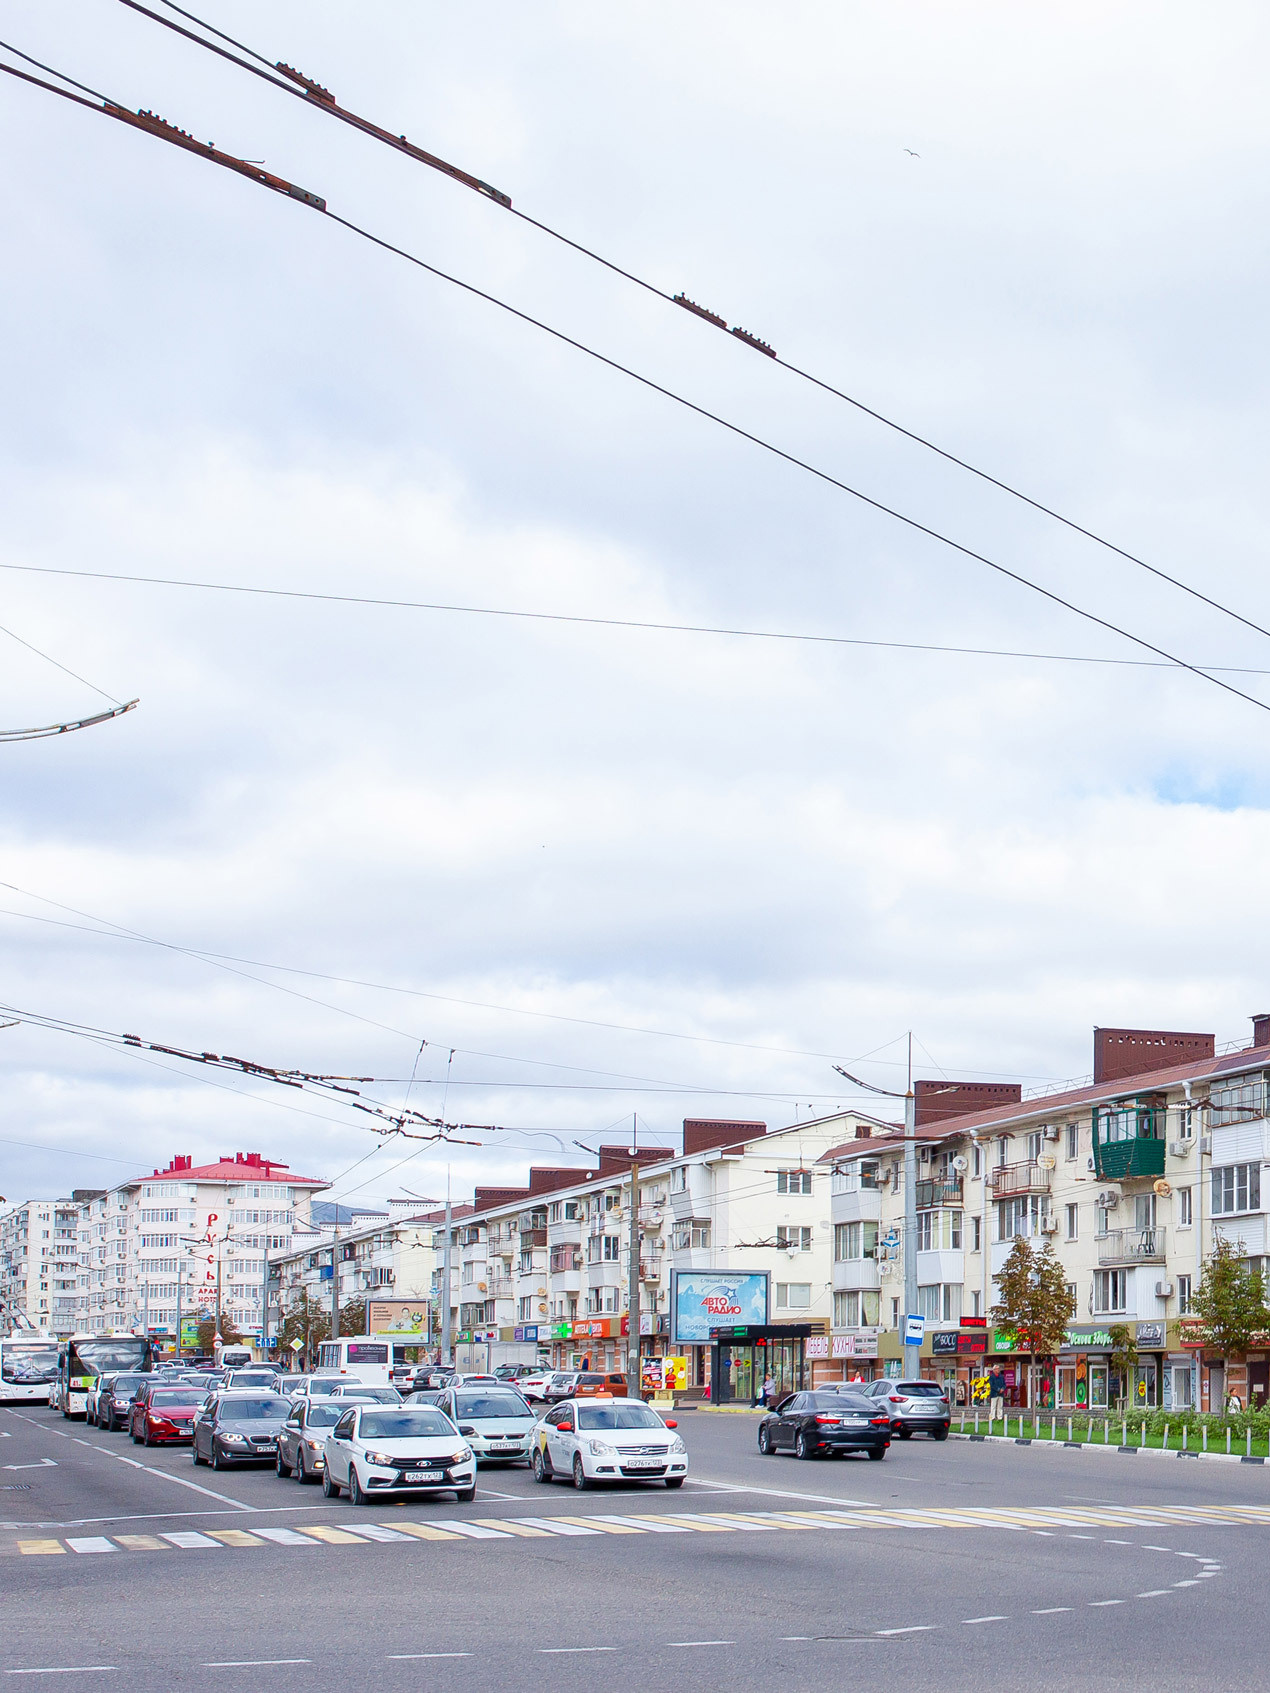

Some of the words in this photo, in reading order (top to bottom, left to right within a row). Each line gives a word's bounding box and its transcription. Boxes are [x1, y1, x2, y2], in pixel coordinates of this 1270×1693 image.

[701, 1297, 728, 1306] АВТО
[708, 1306, 742, 1314] РАДИО
[832, 1336, 856, 1354] КУХНИ
